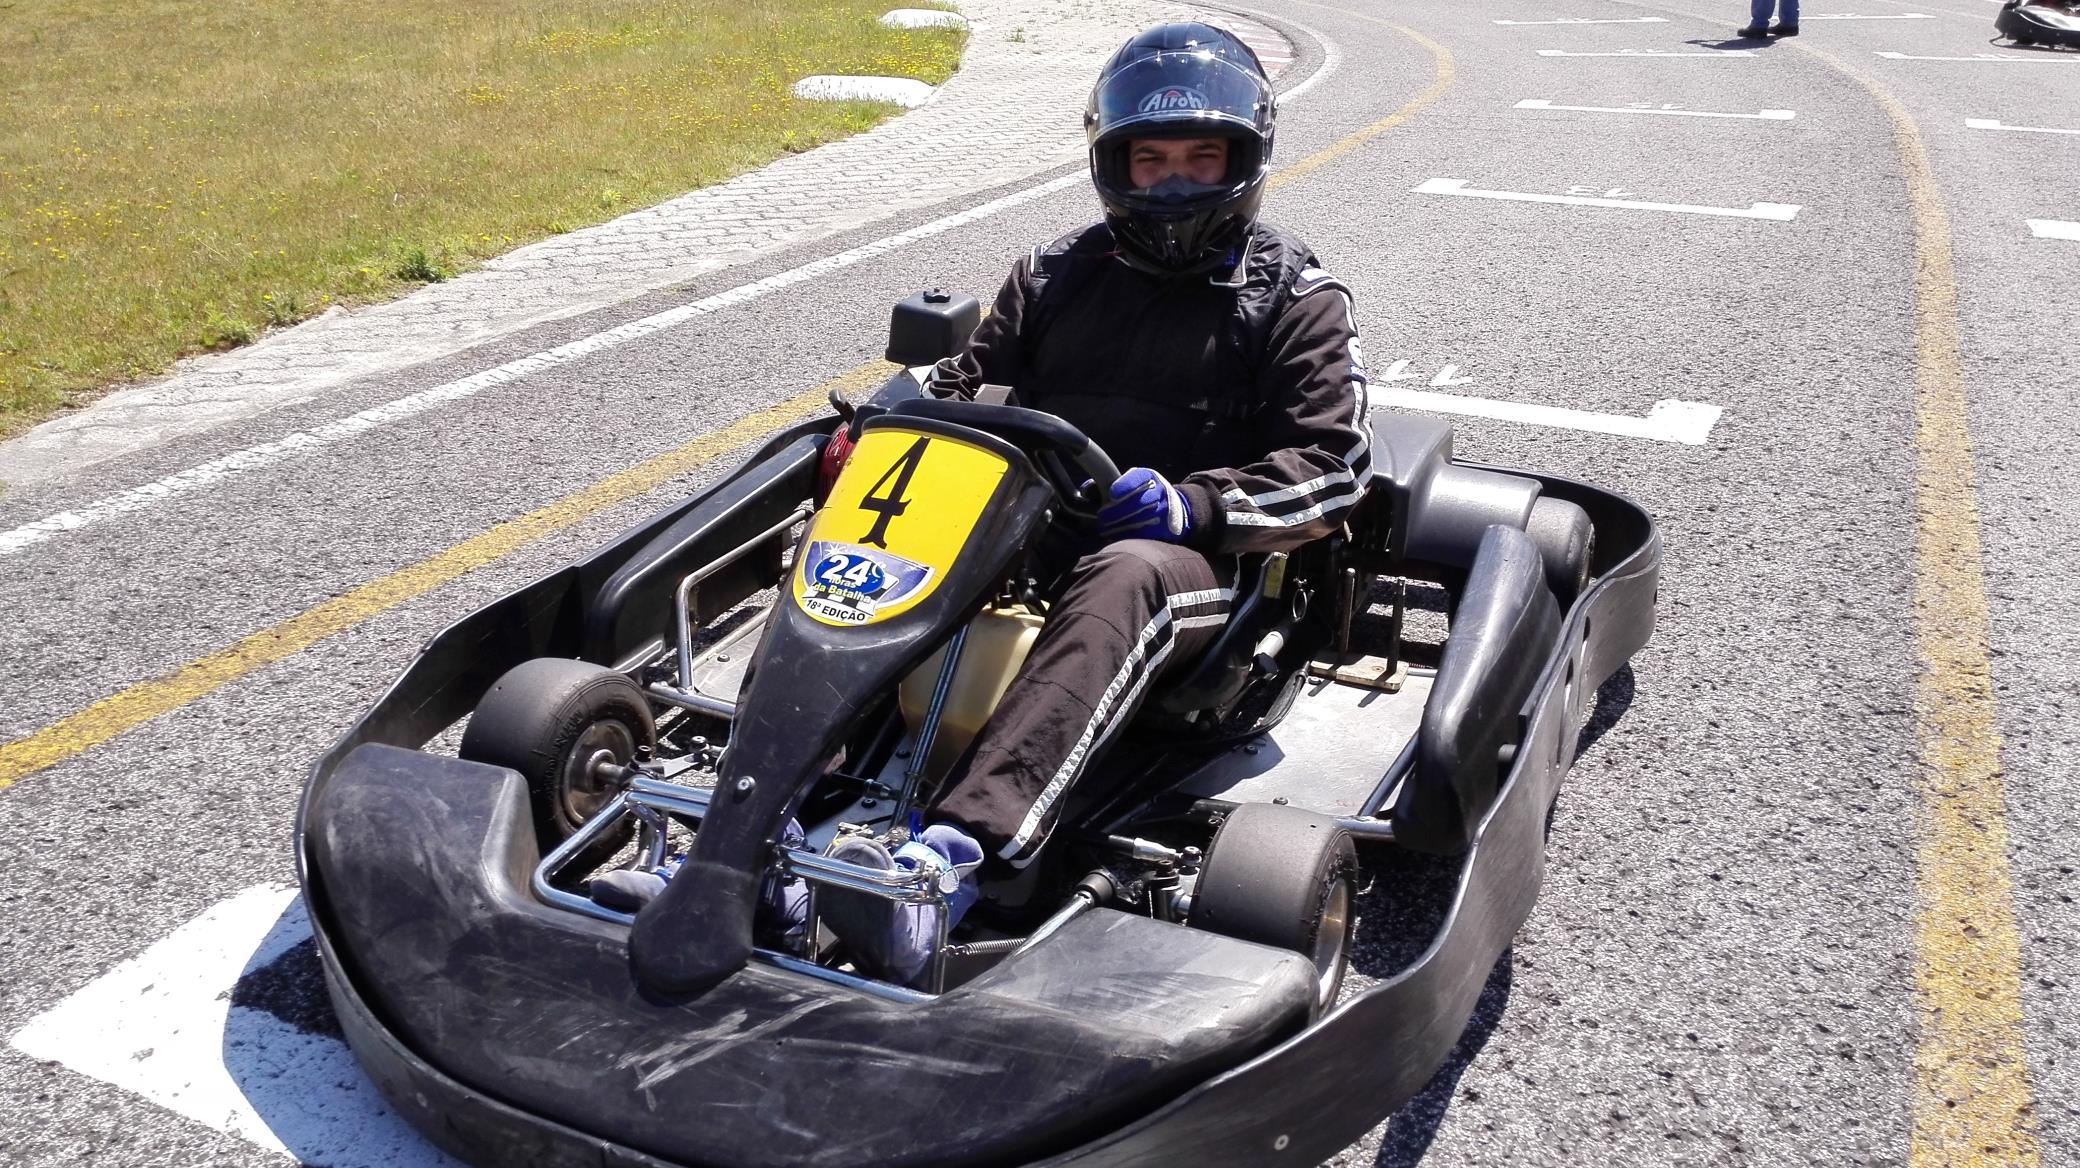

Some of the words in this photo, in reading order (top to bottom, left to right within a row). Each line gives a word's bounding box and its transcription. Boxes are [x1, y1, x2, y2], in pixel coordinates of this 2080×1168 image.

[1143, 91, 1203, 112] Airoh
[858, 437, 931, 549] 4
[821, 554, 873, 586] 24
[814, 583, 826, 592] da
[828, 585, 872, 603] Batalha
[822, 605, 866, 621] EDIÇÃO
